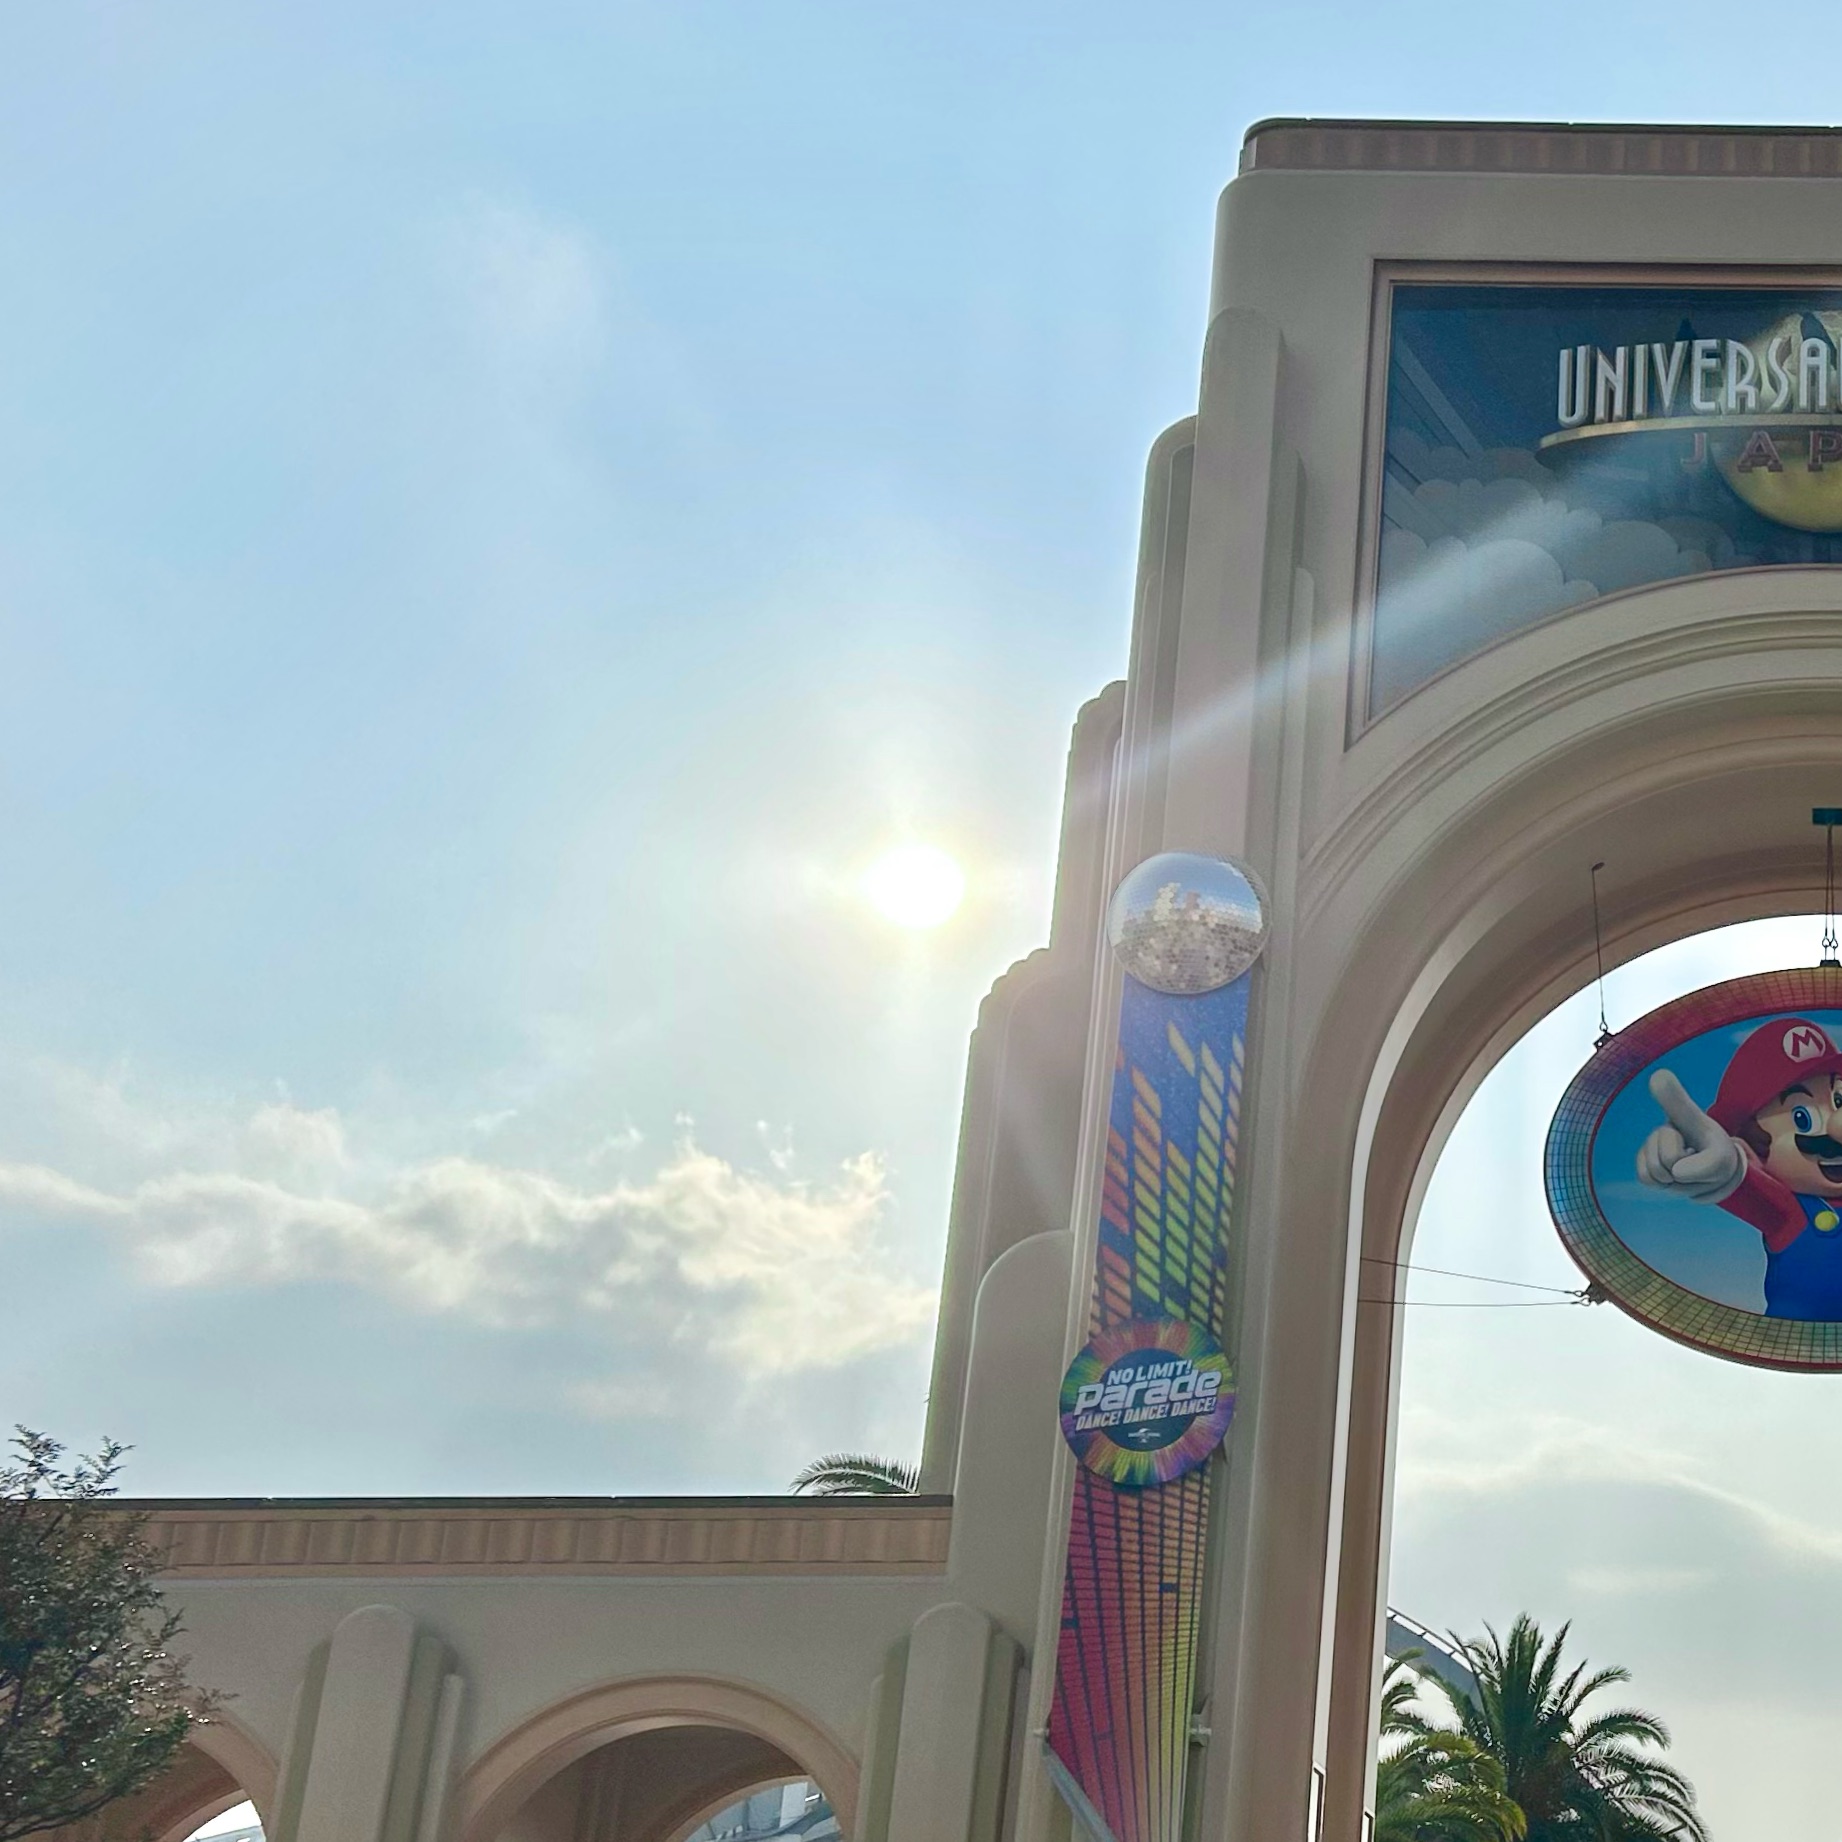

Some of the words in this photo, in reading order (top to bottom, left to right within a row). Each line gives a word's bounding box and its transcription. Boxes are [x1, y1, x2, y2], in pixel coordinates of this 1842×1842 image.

[1791, 1028, 1824, 1058] M
[1108, 1368, 1134, 1385] NO
[1136, 1360, 1192, 1381] LIMIT!
[1074, 1369, 1222, 1415] Parade
[1076, 1412, 1121, 1430] DANCE!
[1124, 1406, 1169, 1424] DANCE!
[1172, 1397, 1217, 1416] DANCE!
